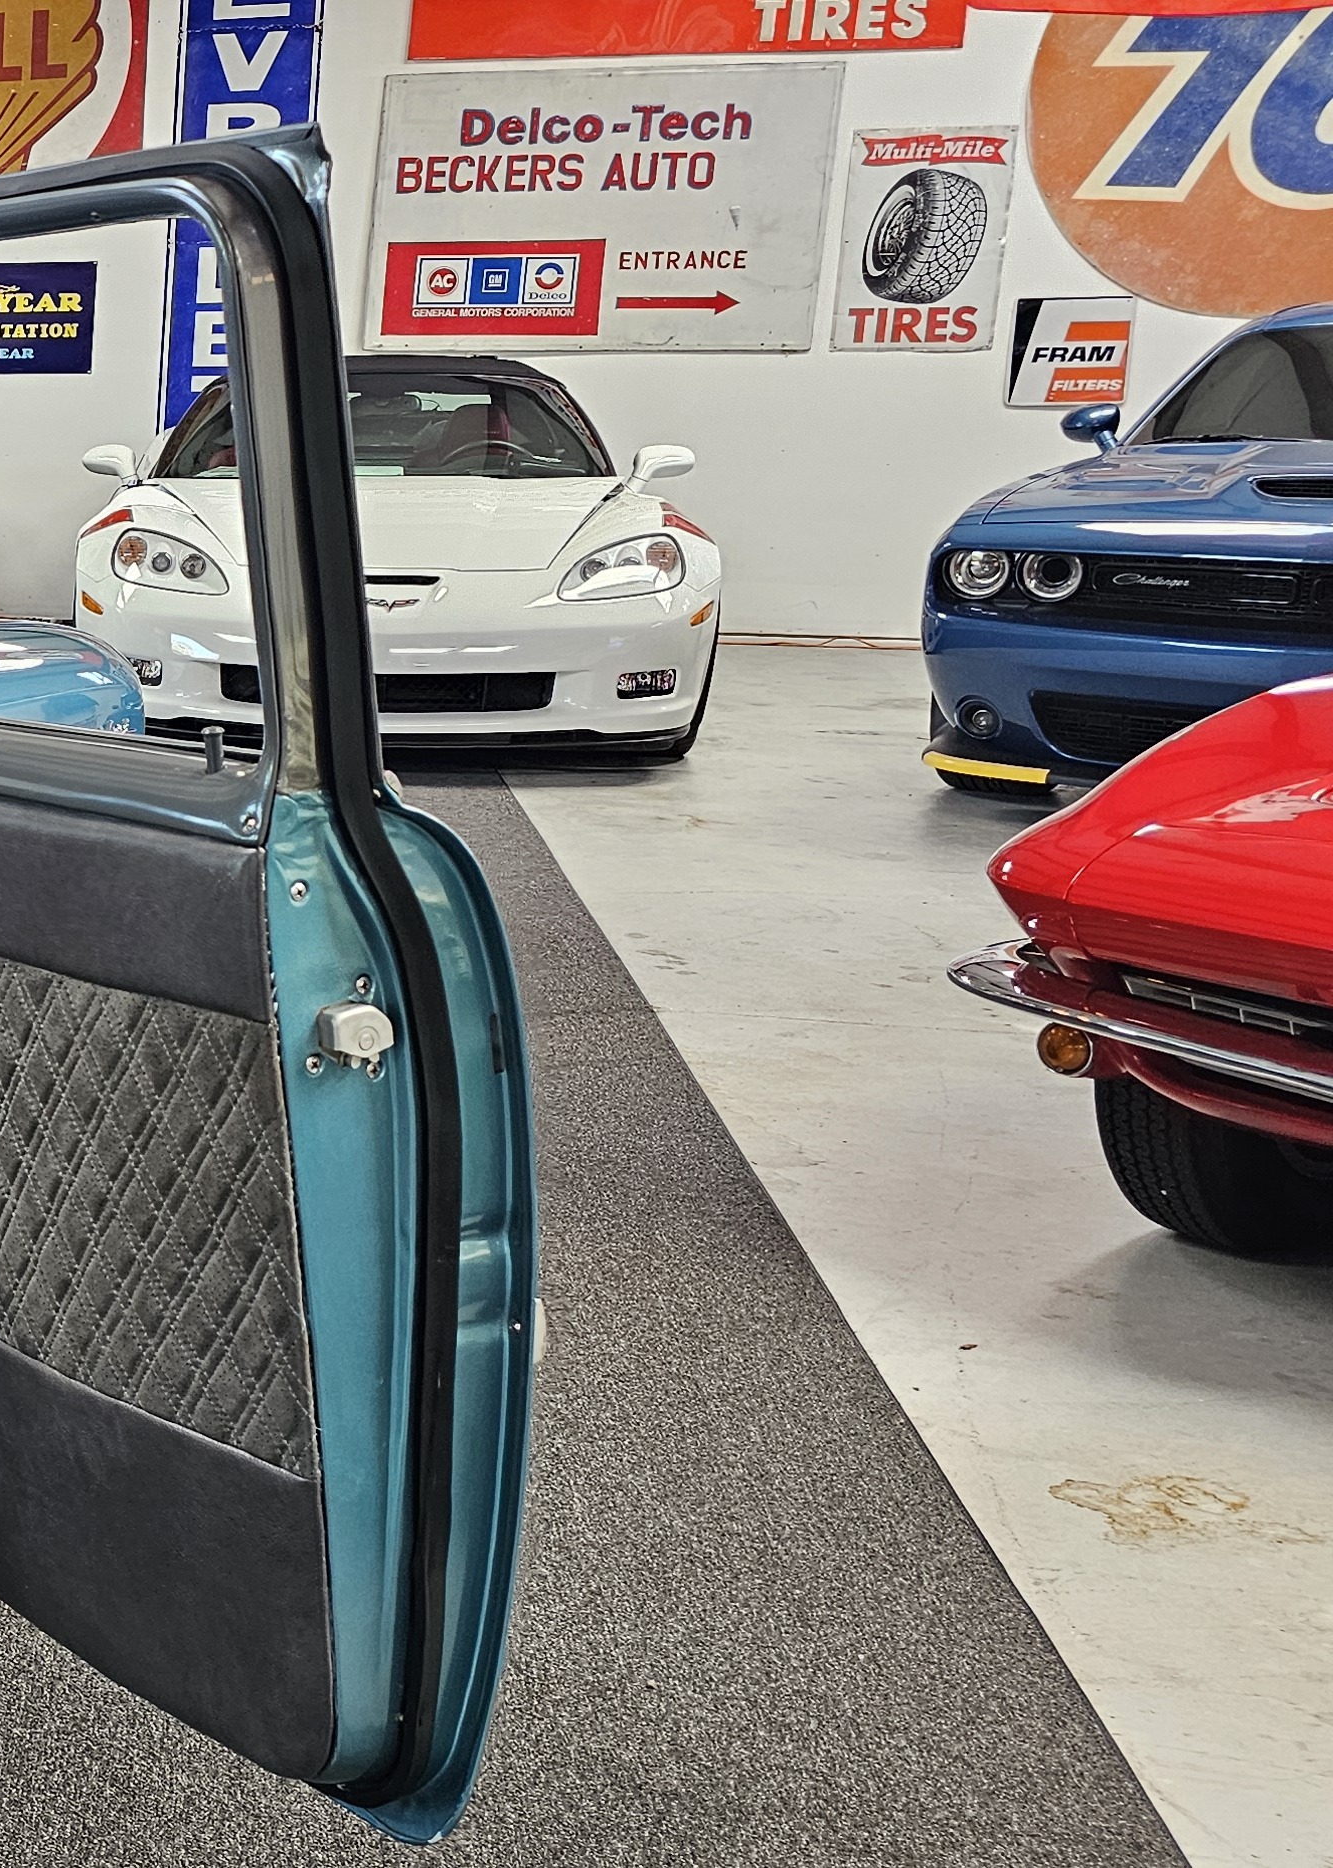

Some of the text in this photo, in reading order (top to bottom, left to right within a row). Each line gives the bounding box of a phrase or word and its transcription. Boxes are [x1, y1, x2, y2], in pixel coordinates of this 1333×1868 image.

[753, 0, 928, 43] TIRES
[867, 139, 997, 163] Multi-Mile
[395, 151, 717, 195] BECKERS AUTO
[618, 249, 749, 271] ENTRANCE
[429, 273, 455, 289] AC
[488, 273, 503, 285] GM
[528, 291, 567, 300] Delco
[411, 307, 575, 318] GENERAL MOTORS CORPORATION
[847, 306, 979, 344] TIRES
[1030, 345, 1117, 364] FRAM
[1051, 377, 1124, 392] FILTERS
[1112, 572, 1190, 589] Challenger
